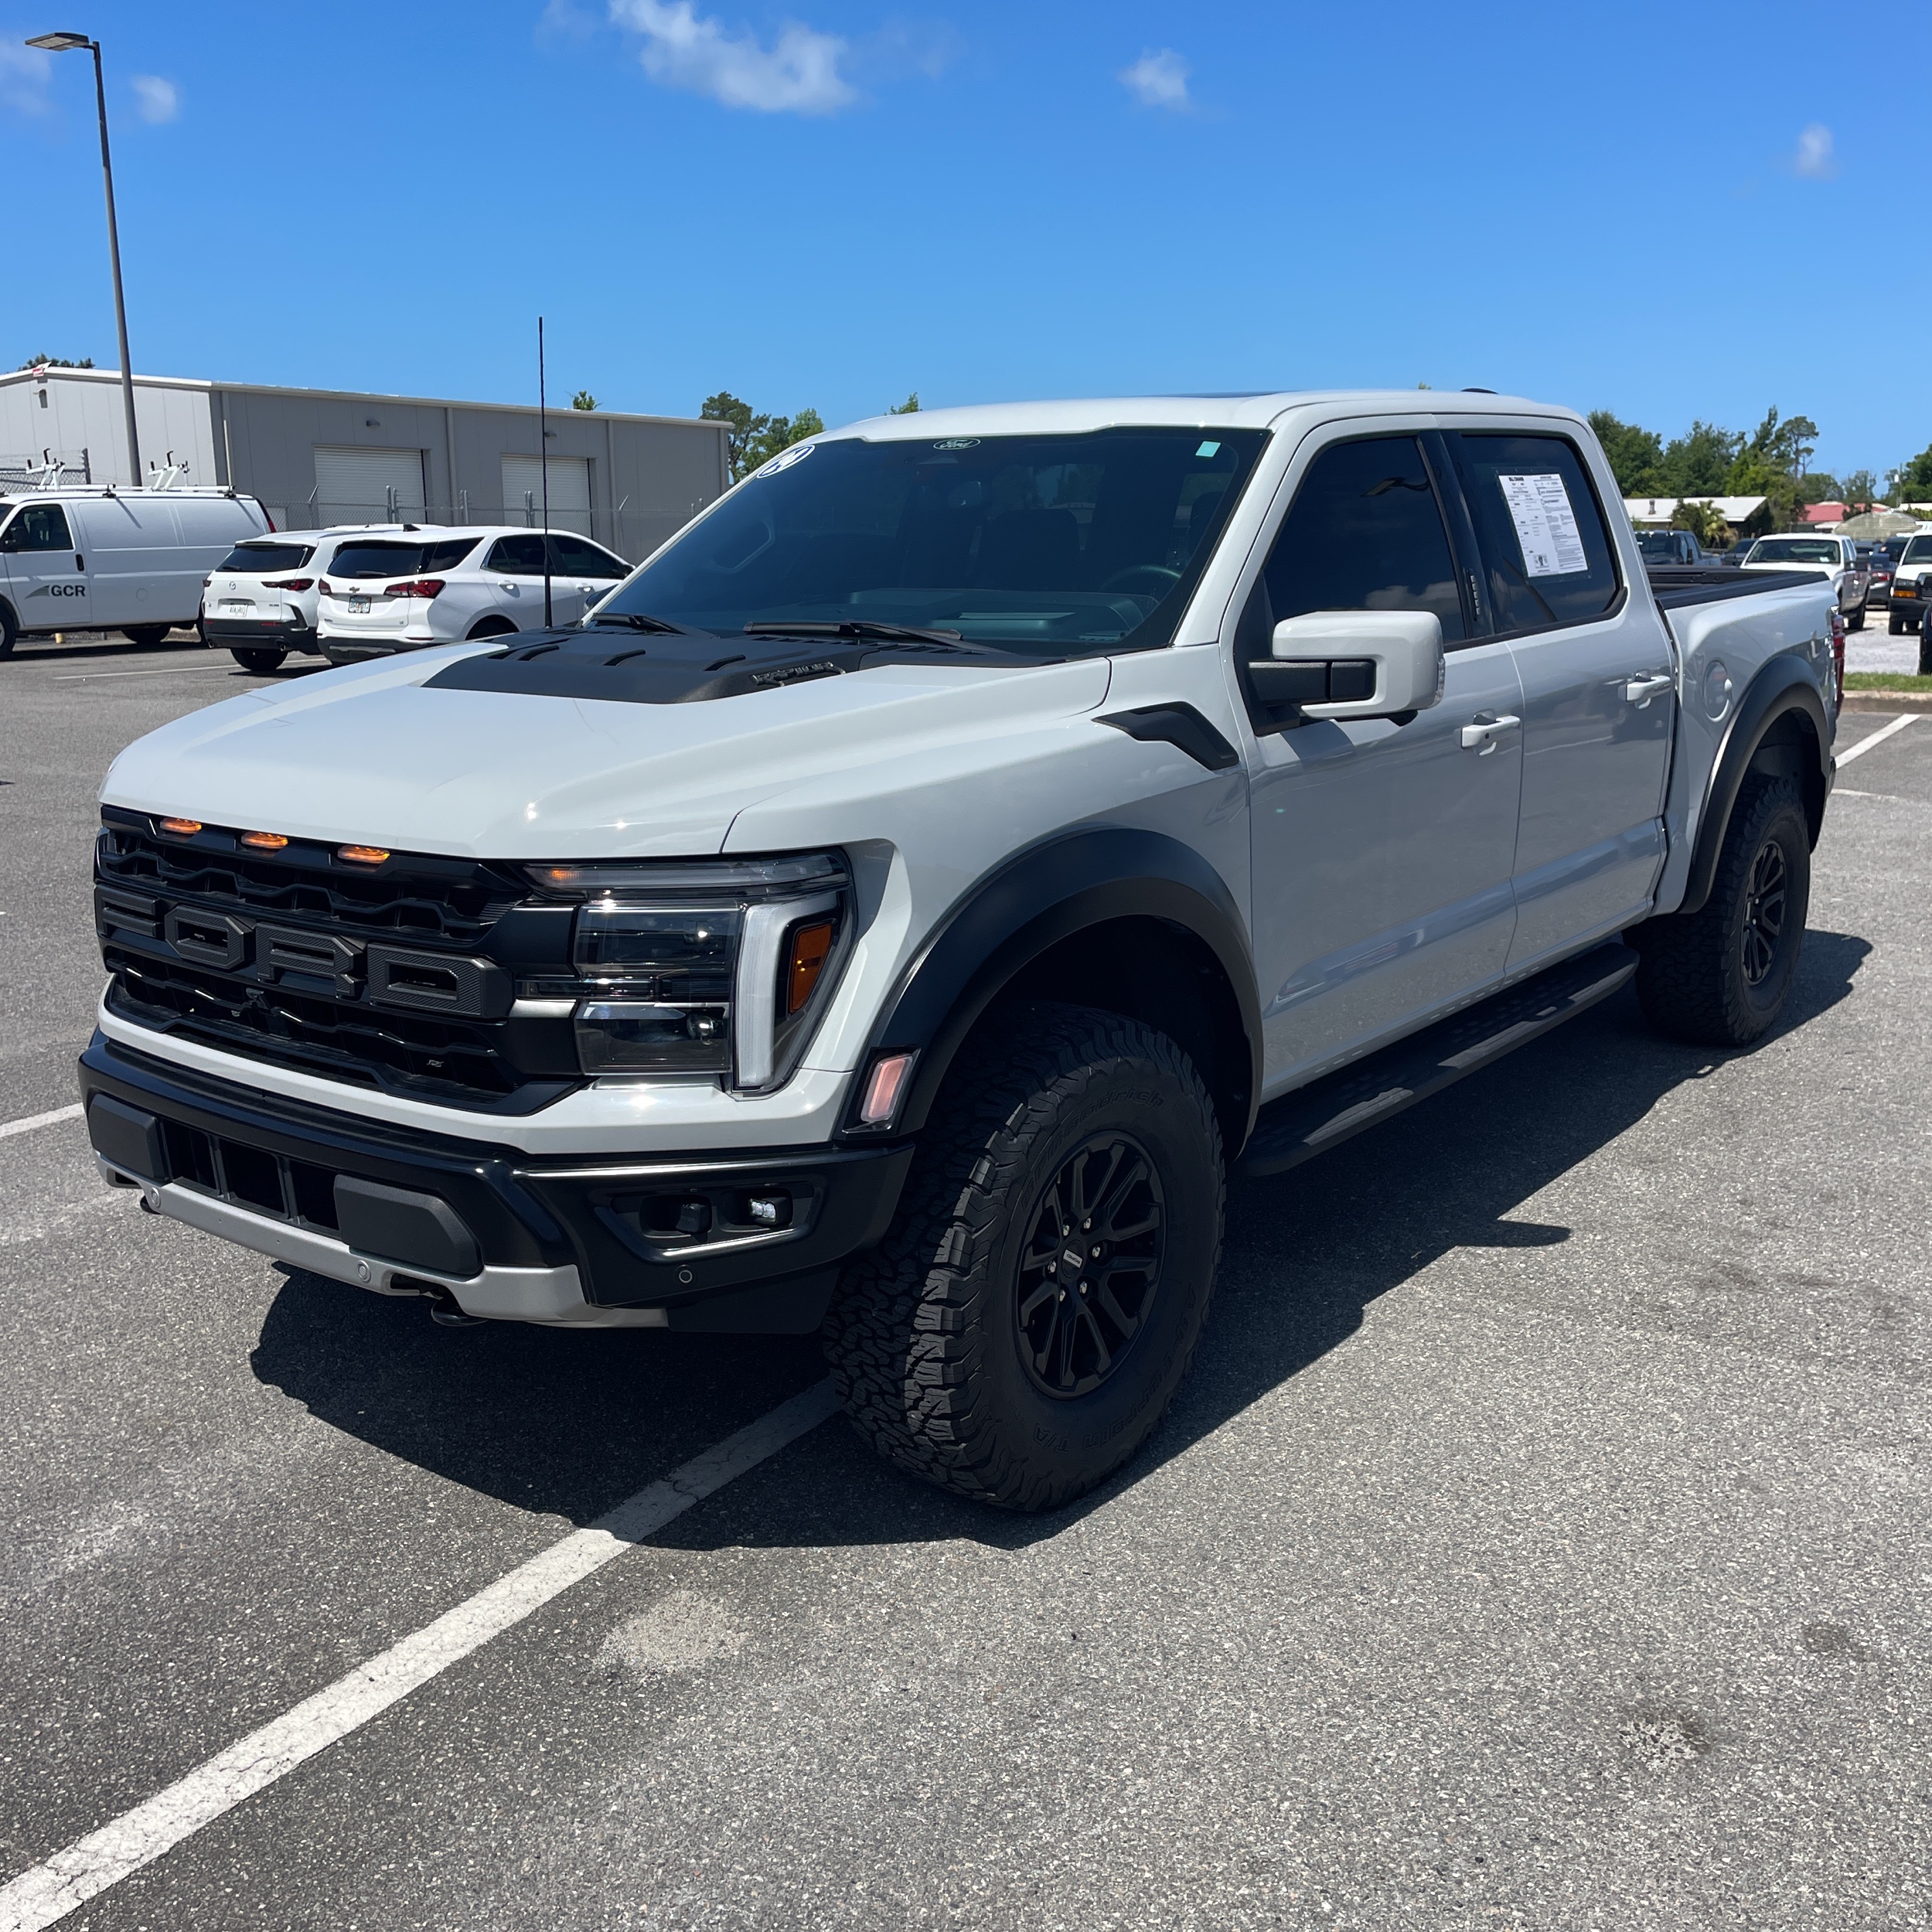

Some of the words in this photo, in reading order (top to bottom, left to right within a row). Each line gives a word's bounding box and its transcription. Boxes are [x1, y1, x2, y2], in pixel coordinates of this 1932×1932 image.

[939, 439, 974, 448] Ford
[50, 584, 86, 597] GCR
[95, 885, 495, 1017] FORD
